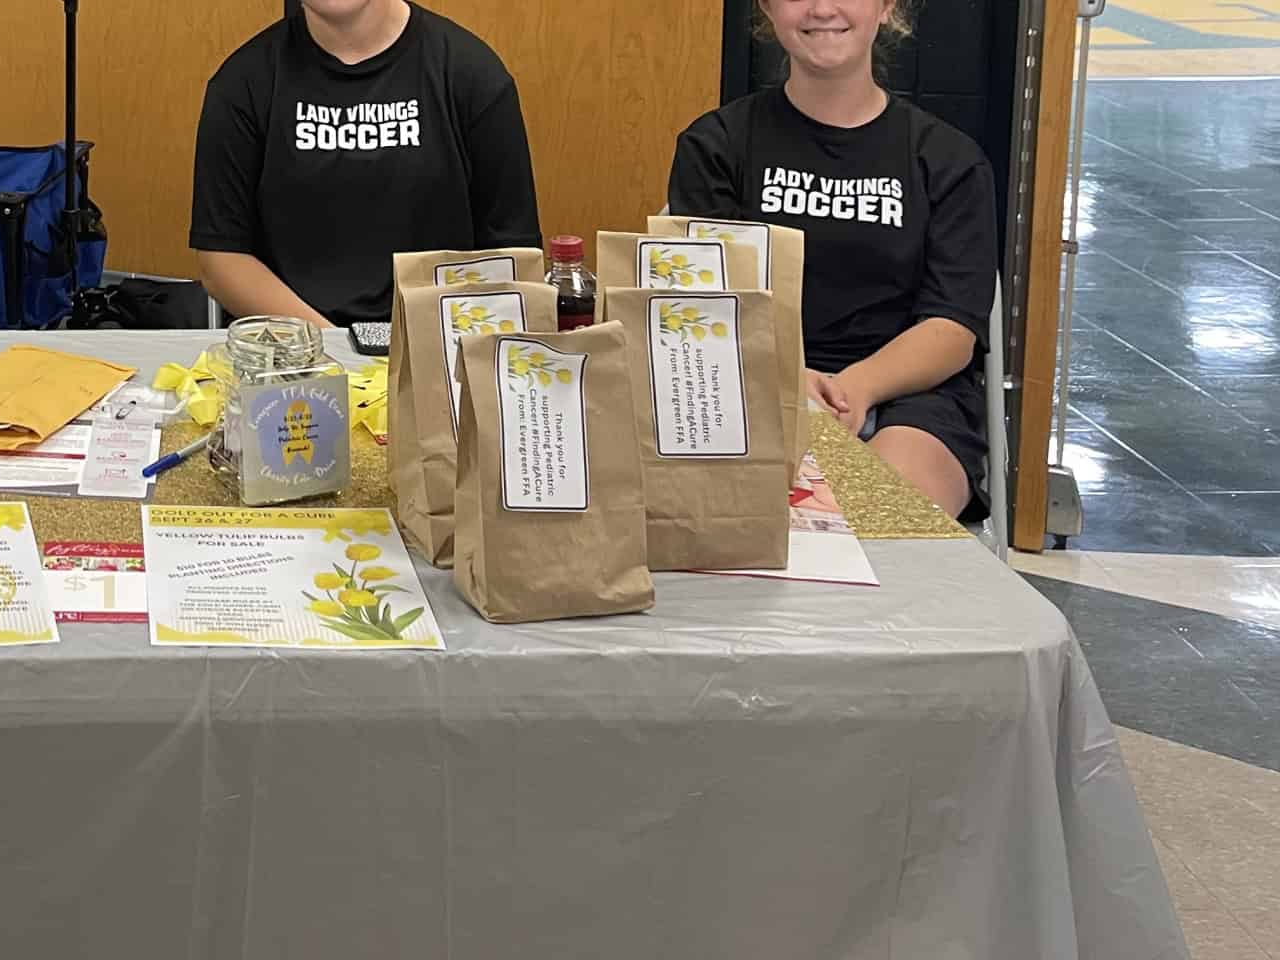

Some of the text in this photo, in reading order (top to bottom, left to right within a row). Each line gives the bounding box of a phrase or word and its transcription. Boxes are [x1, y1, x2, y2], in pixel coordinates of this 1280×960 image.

[296, 100, 418, 126] LADY VIKINGS
[296, 119, 420, 150] SOCCER
[763, 167, 903, 199] LADY VIKINGS
[761, 186, 903, 227] SOCCER
[671, 377, 682, 424] Evergreen
[696, 349, 710, 443] supporting Pediatric
[711, 364, 723, 427] Thank you for
[519, 426, 527, 474] Evergreen
[542, 396, 555, 496] supporting Pediatric
[676, 426, 684, 444] FFA
[555, 444, 564, 462] you
[522, 477, 530, 496] FFA
[558, 465, 566, 479] for
[151, 509, 197, 517] GOLD
[197, 559, 221, 568] FOR
